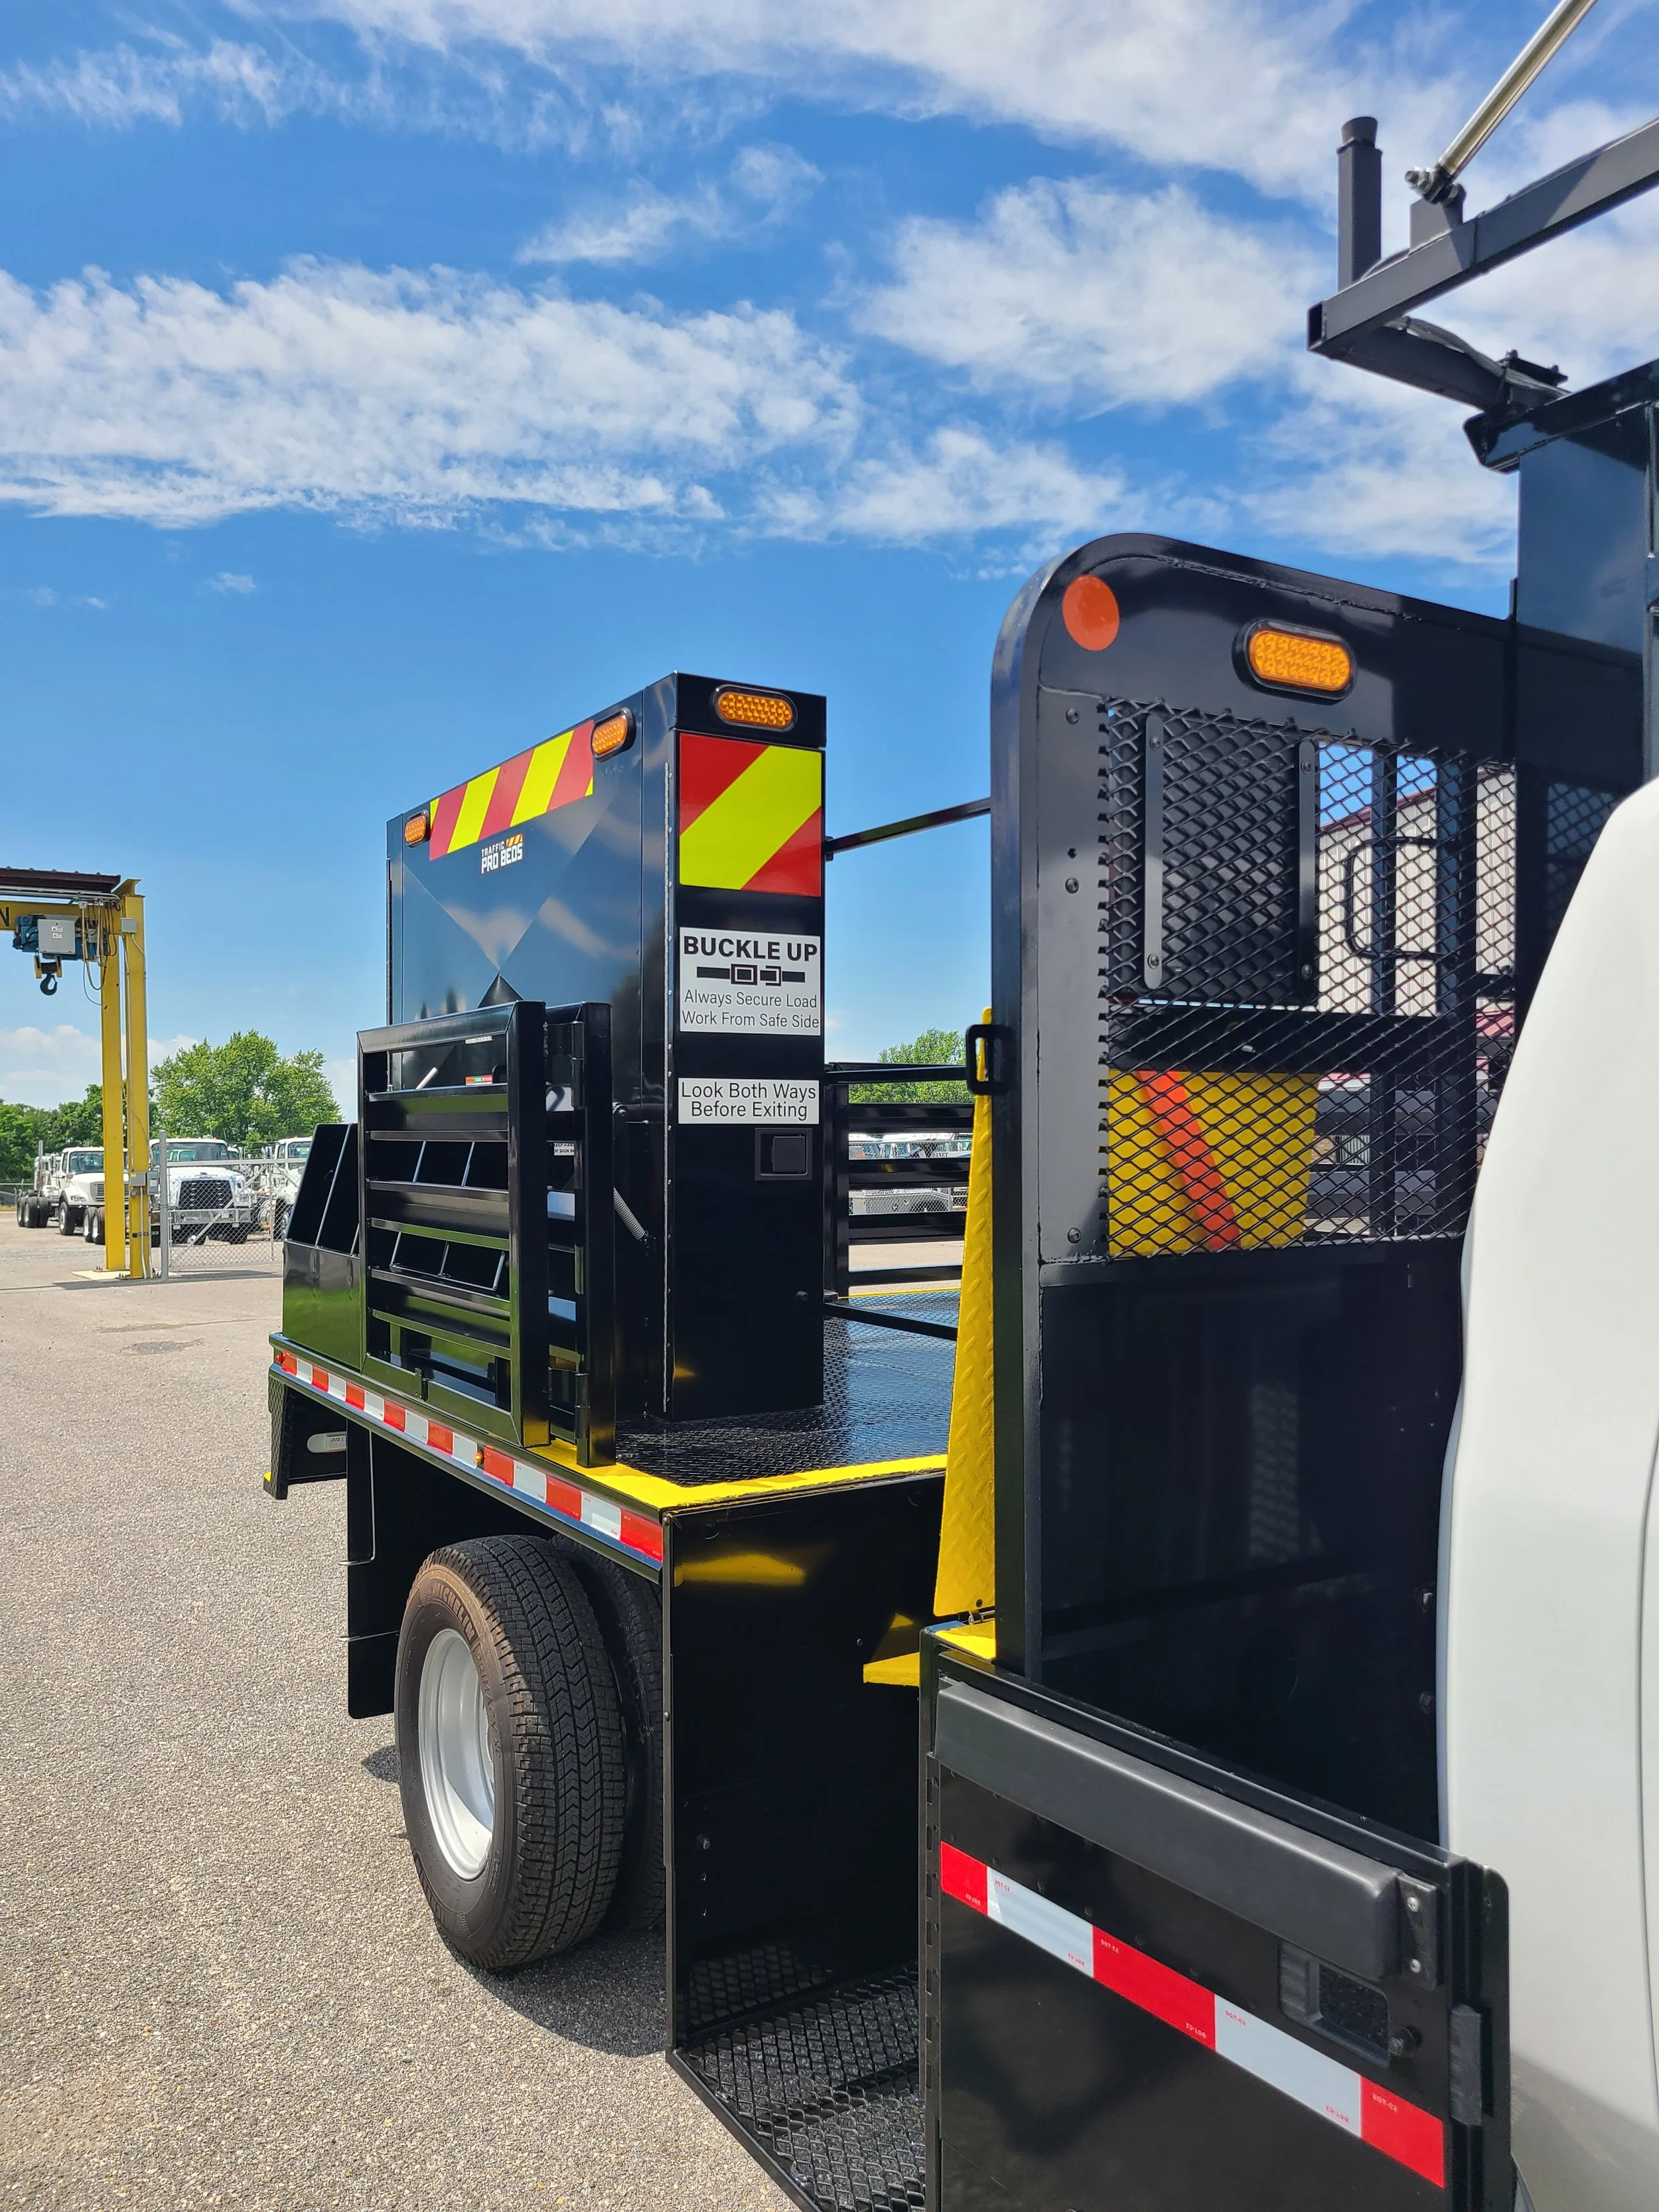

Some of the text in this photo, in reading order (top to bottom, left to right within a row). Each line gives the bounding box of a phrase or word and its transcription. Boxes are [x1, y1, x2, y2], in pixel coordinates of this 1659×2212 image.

[481, 841, 505, 857] TRAFFIC
[481, 842, 523, 874] PRO BEDS
[684, 935, 818, 962] BUCKLE UP
[684, 989, 817, 1008] Always Secure Load
[682, 1010, 819, 1029] Work From Safe Side
[682, 1082, 816, 1102] Look Both Ways
[691, 1100, 808, 1121] Before Exiting
[432, 1582, 475, 1642] MICHELIN
[475, 1653, 498, 1732] PRIMACY
